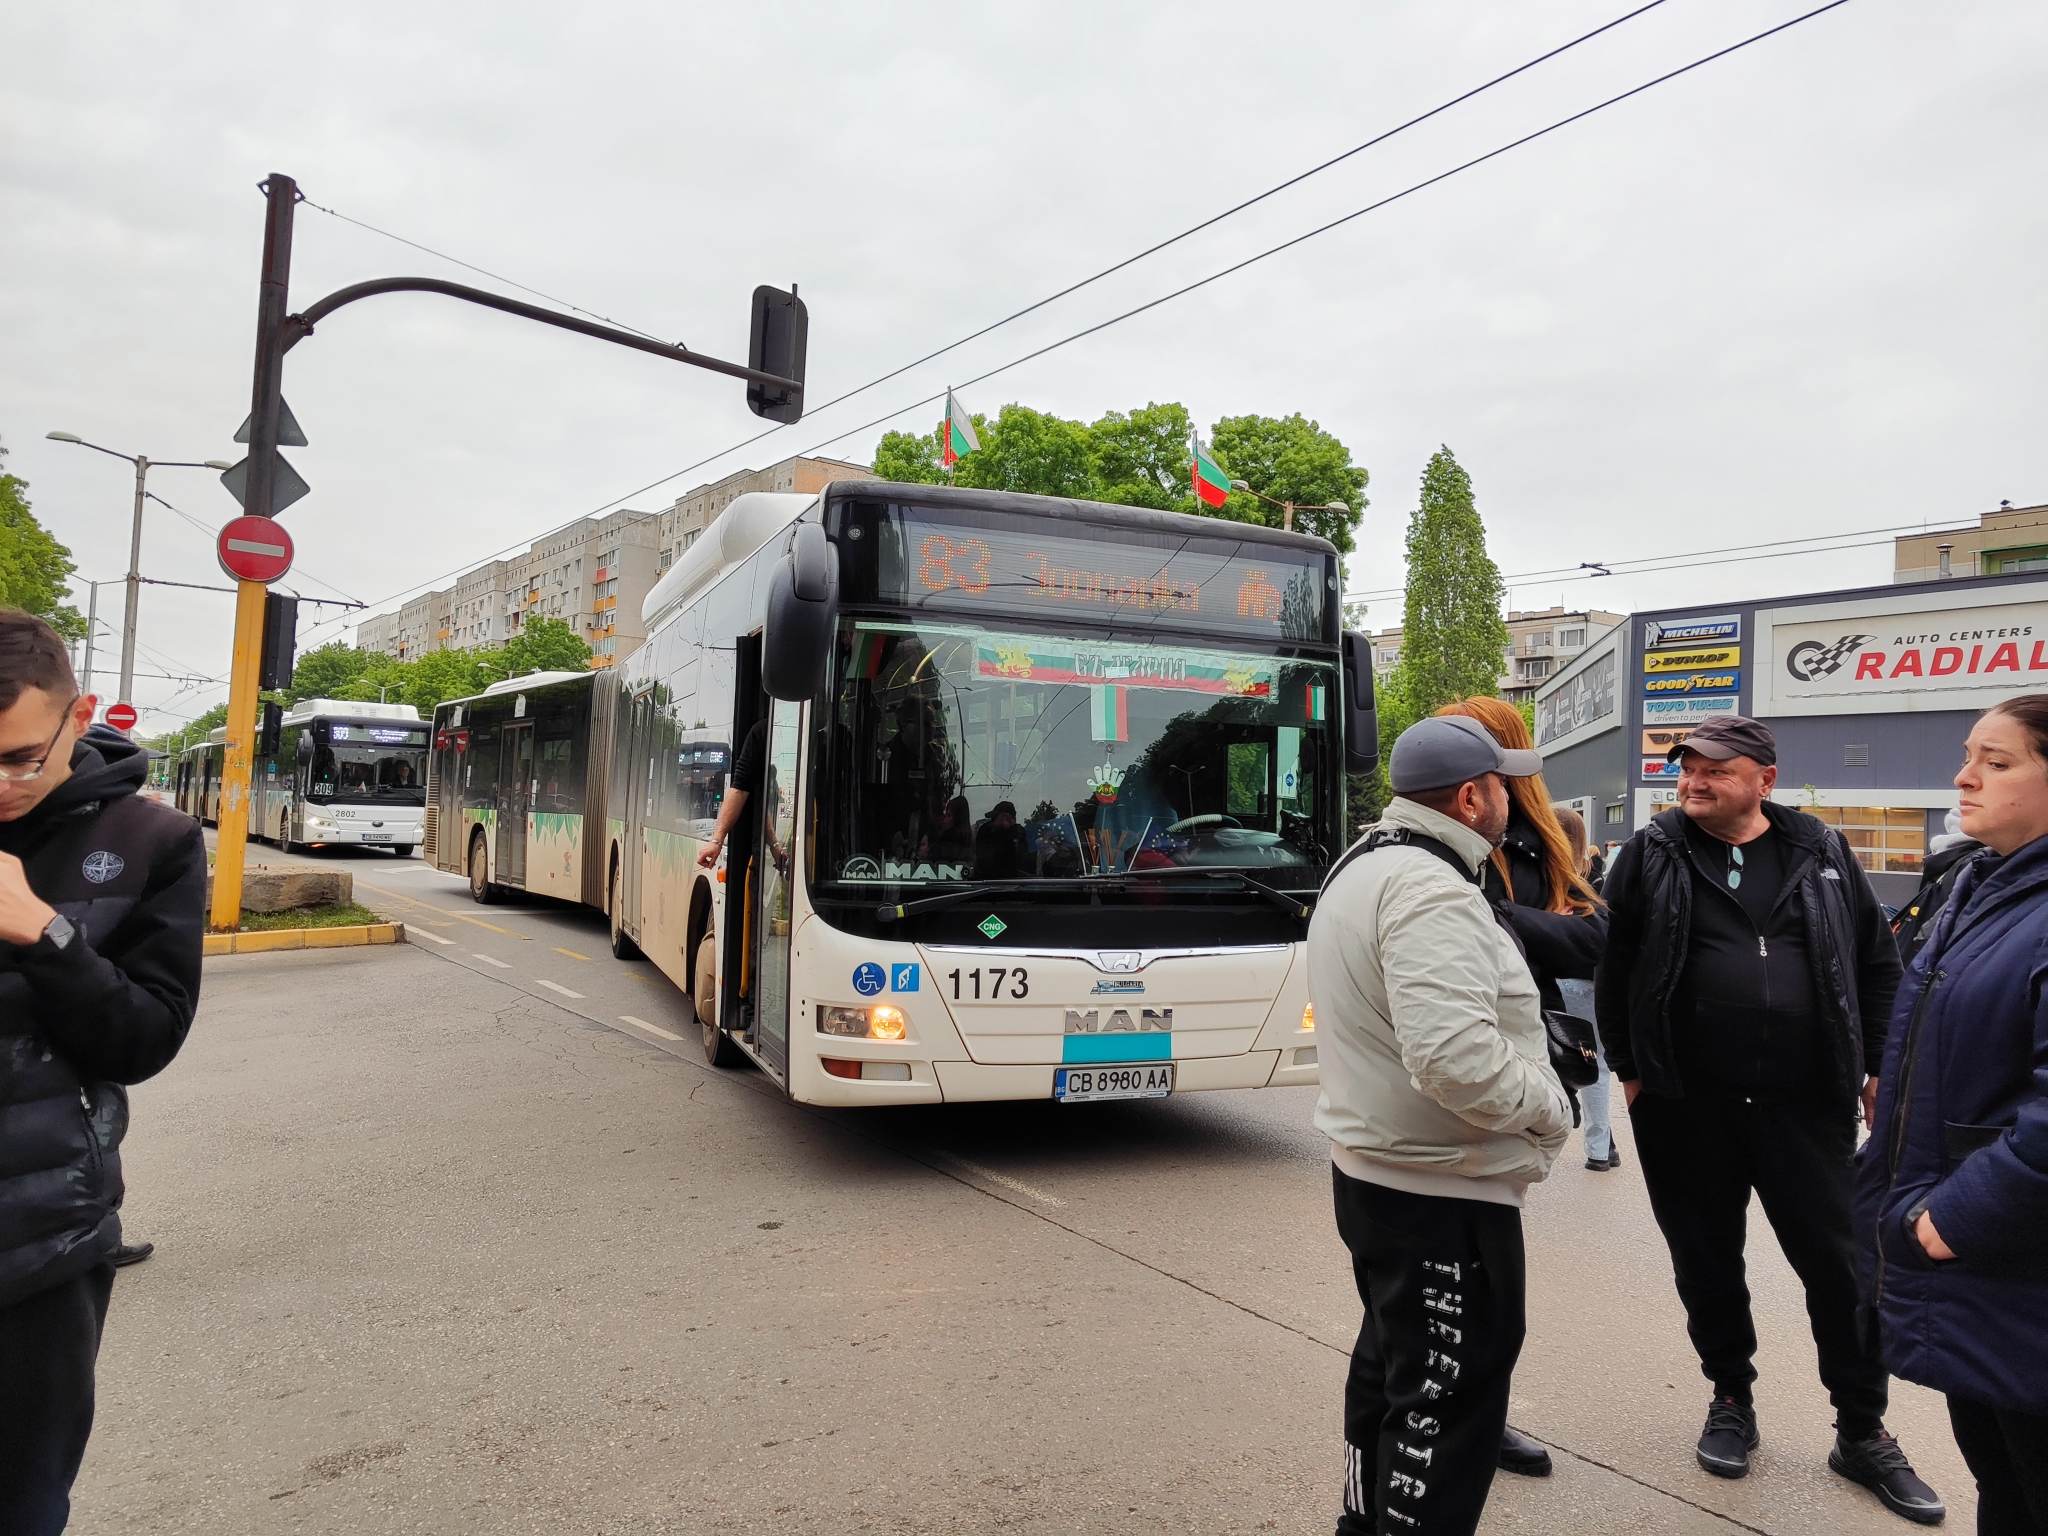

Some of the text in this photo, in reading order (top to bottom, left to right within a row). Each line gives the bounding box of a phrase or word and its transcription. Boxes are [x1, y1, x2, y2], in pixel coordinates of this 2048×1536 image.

[919, 535, 992, 593] 83
[1664, 624, 1735, 639] MICHELIN
[1893, 626, 2033, 646] AUTO CENTERS
[1662, 652, 1730, 666] DUNLOP
[1855, 640, 2048, 681] RADIAL
[1646, 698, 1734, 712] TOYO TIRES
[1654, 713, 1679, 722] driven
[315, 783, 333, 795] 309
[335, 810, 356, 818] 2802
[846, 871, 879, 879] MAN
[885, 862, 964, 880] MAN
[983, 922, 1001, 931] CNG
[948, 968, 1029, 999] 1173
[1064, 1008, 1173, 1032] MAN
[1069, 1069, 1169, 1093] CB 8980 AA
